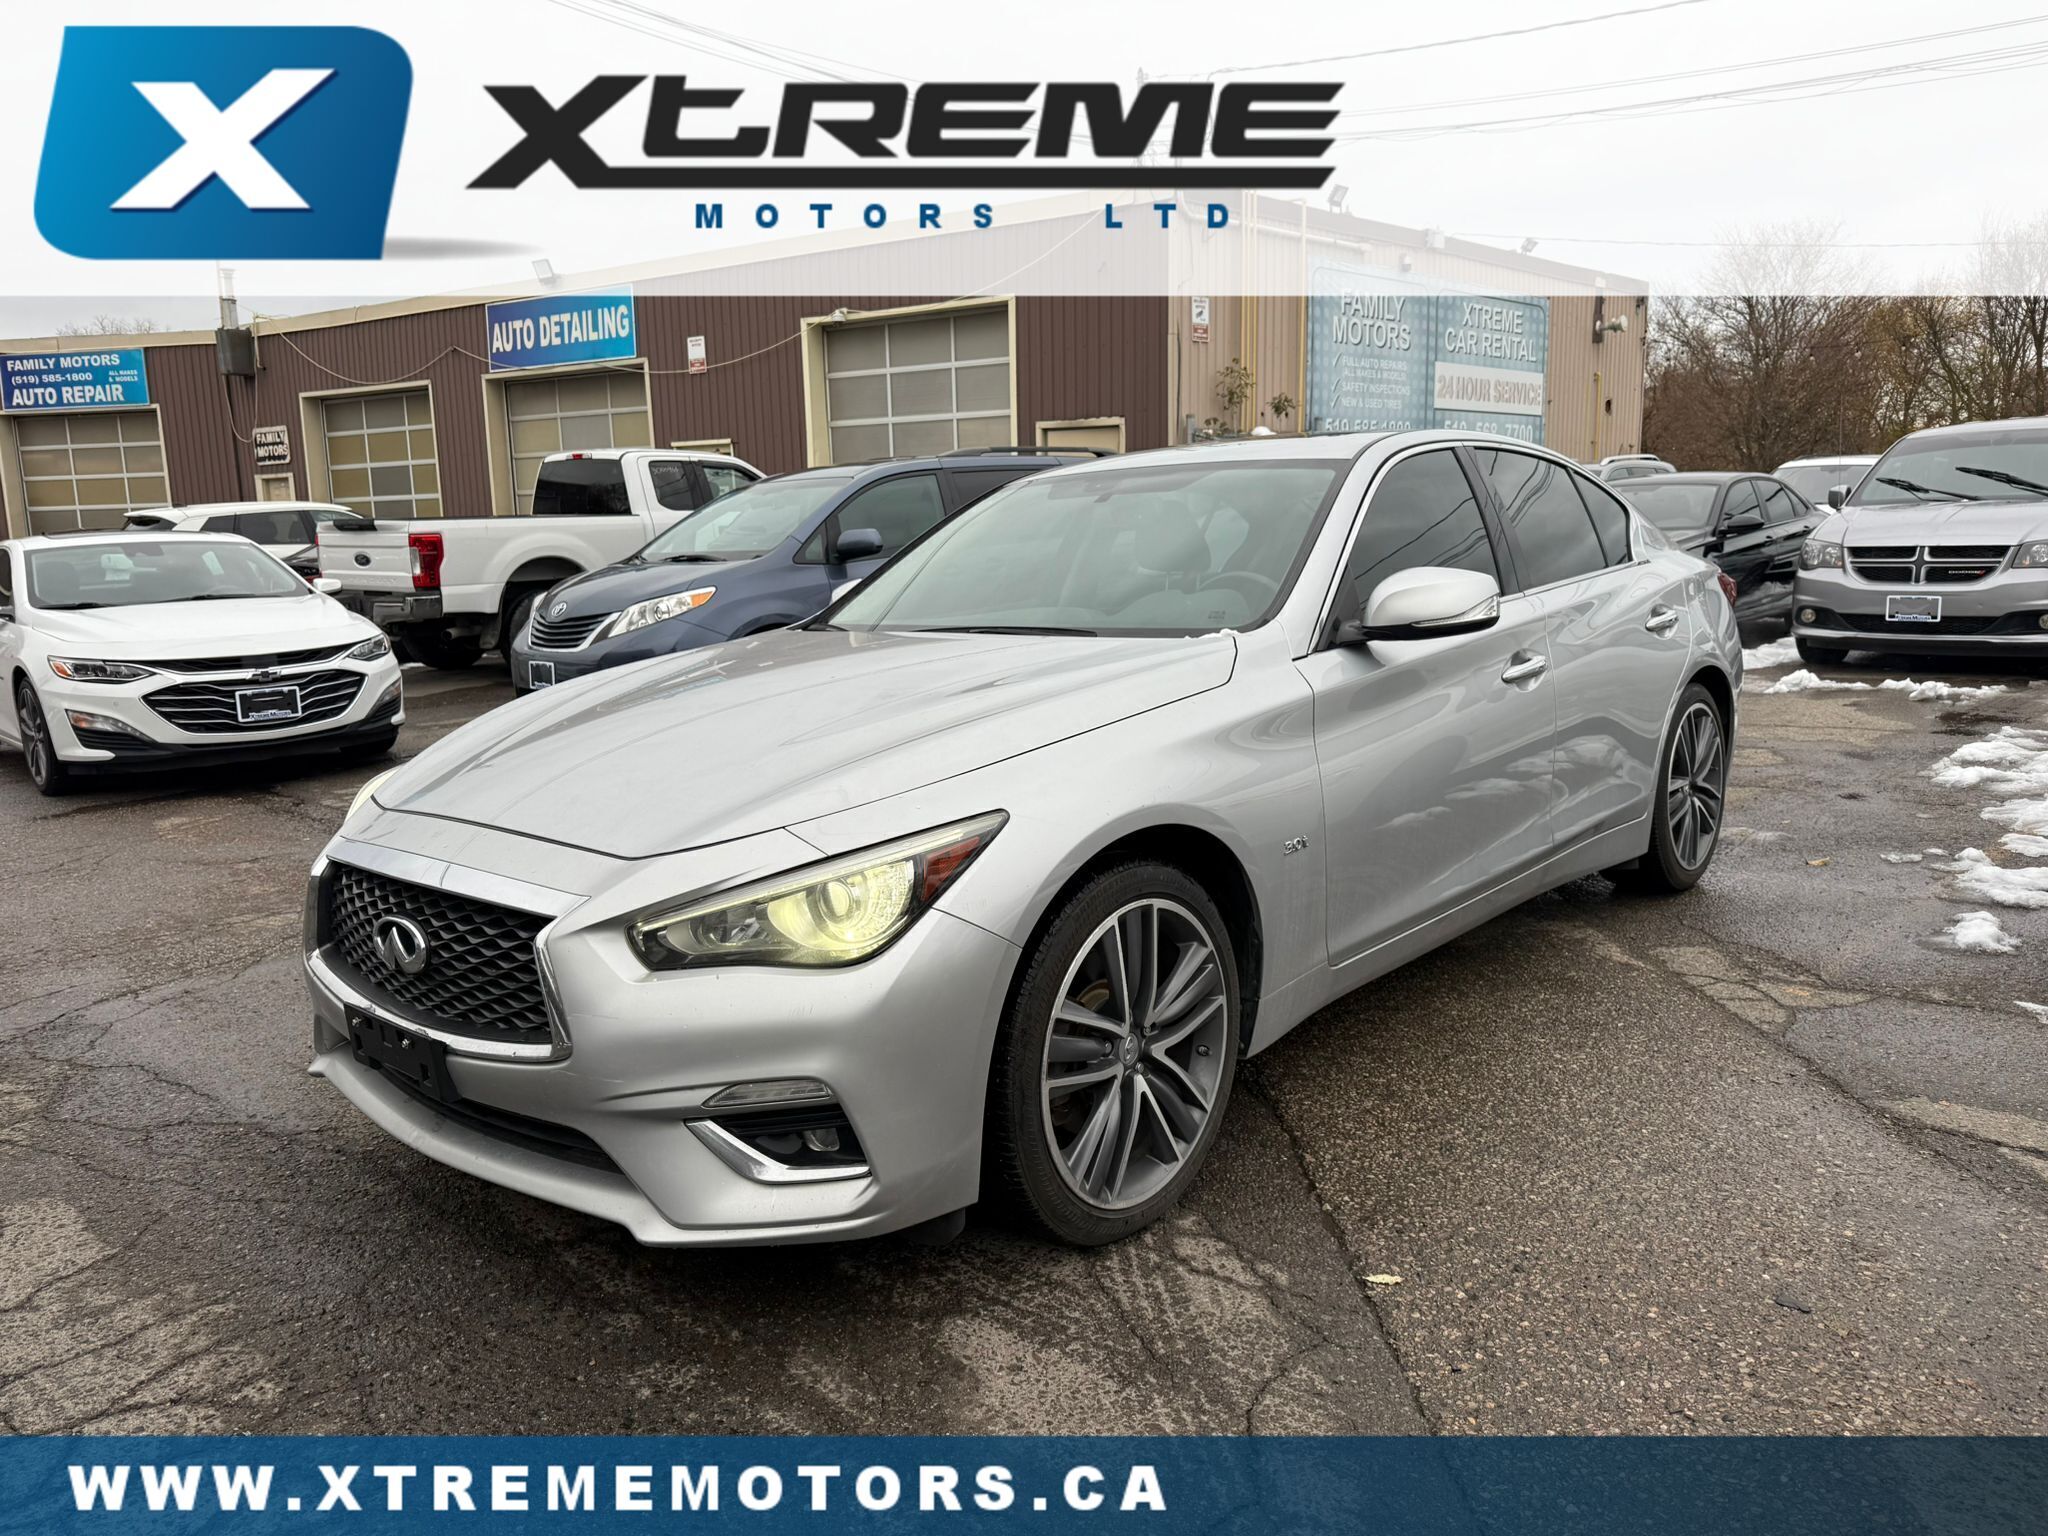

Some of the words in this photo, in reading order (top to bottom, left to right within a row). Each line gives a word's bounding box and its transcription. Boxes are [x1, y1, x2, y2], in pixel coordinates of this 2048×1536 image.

[1341, 288, 1405, 322] FAMILY
[1462, 302, 1523, 335] XTREME
[492, 318, 534, 353] AUTO
[539, 304, 630, 347] DETAILING
[1333, 316, 1411, 351] MOTORS
[1445, 328, 1478, 356] CAR
[1482, 332, 1537, 363] RENTAL
[7, 358, 55, 372] FAMILY
[60, 354, 120, 368] MOTORS
[11, 375, 39, 386] (519)
[42, 372, 93, 383] 585-1800
[1436, 375, 1454, 400] 24
[1456, 376, 1491, 402] HOUR
[1494, 379, 1542, 406] SERVICE
[12, 387, 57, 406] AUTO
[61, 384, 125, 404] REPAIR
[256, 431, 285, 444] FAMILY
[257, 444, 289, 457] MOTORS
